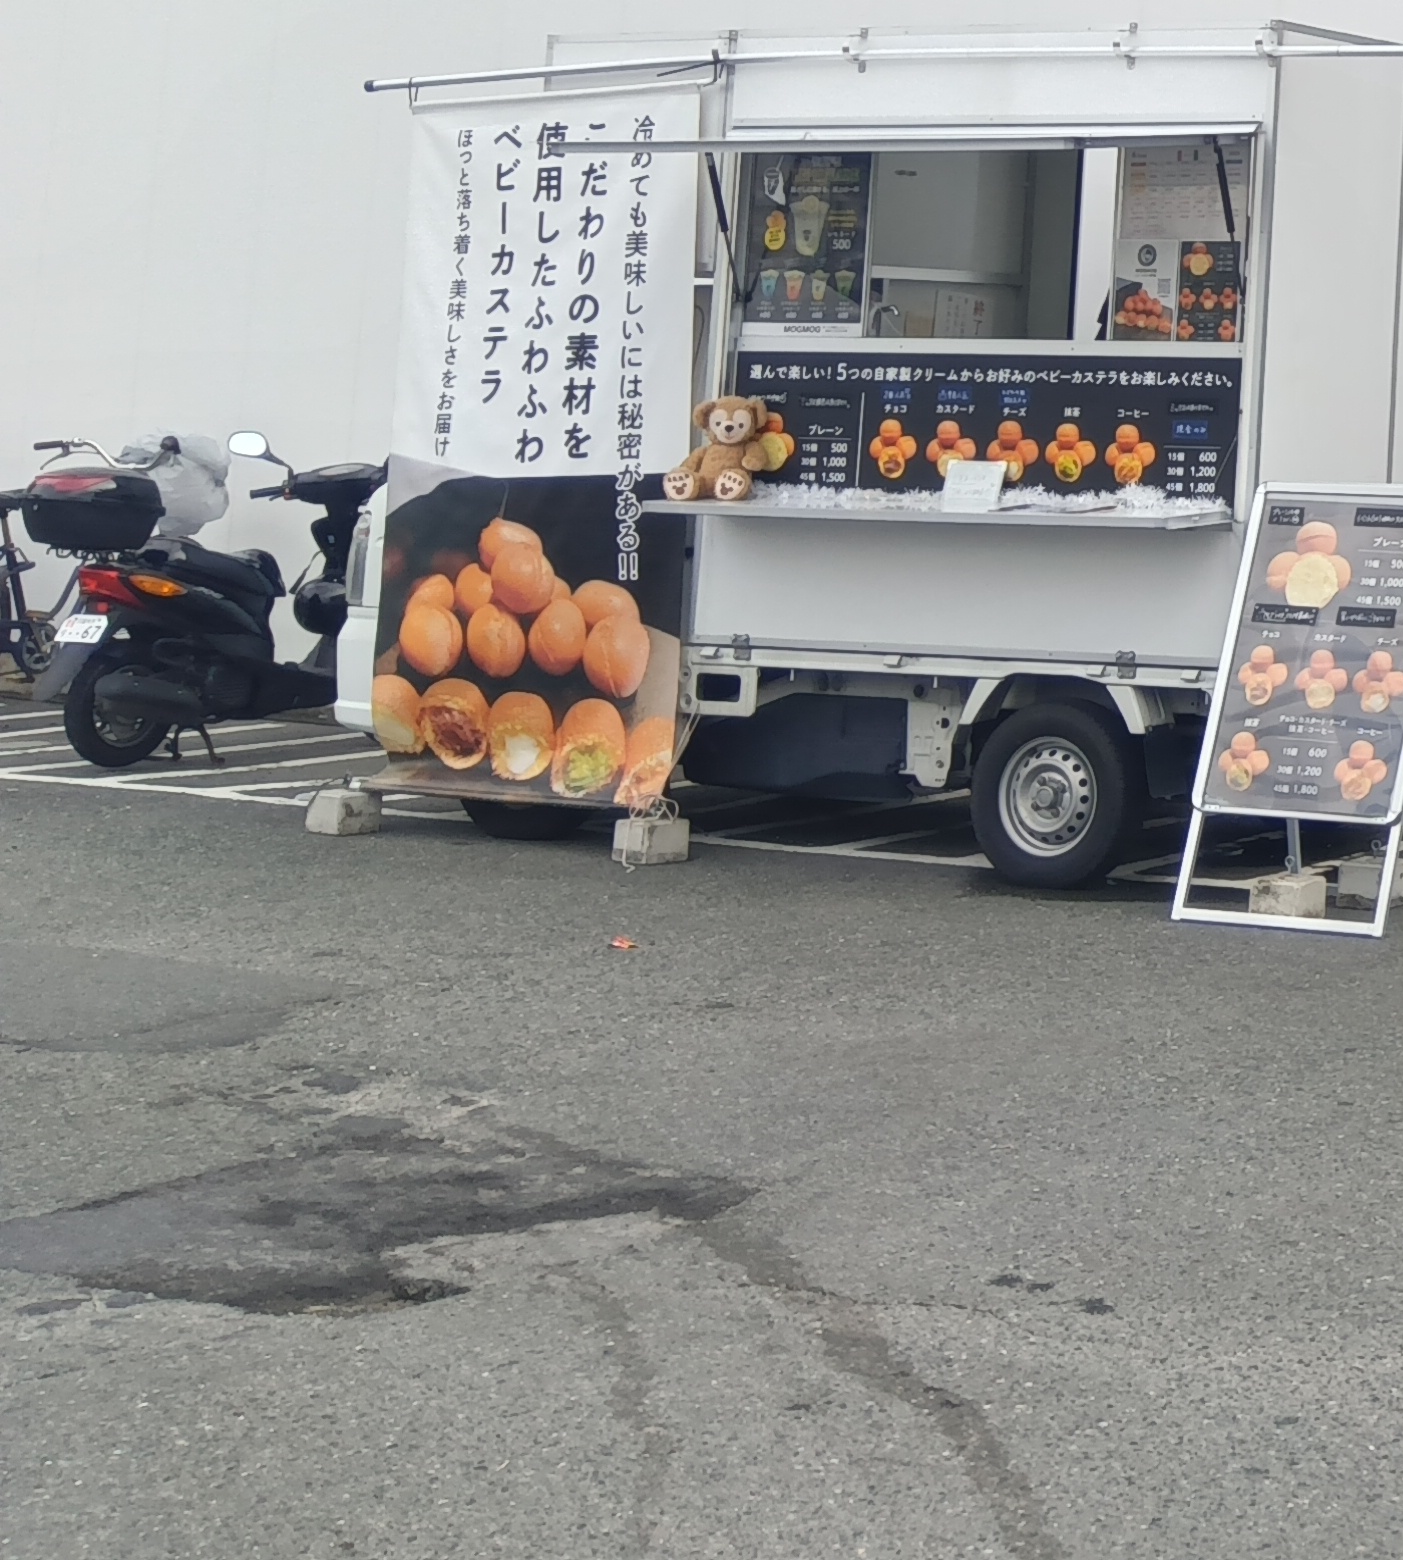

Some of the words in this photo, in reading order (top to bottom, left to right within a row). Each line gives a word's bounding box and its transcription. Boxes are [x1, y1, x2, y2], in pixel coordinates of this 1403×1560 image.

[832, 239, 851, 250] 500
[481, 123, 523, 405] ベビーカステラ
[434, 129, 474, 458] ほっと落ち着く美味しさをお届け
[516, 122, 568, 464] 使用したふわふわ
[883, 404, 908, 414] チョコ
[935, 404, 976, 415] カスタード
[1002, 406, 1027, 417] チーズ
[1116, 409, 1150, 418] コーヒー
[808, 424, 844, 436] プレーン
[830, 442, 848, 453] 500
[822, 456, 847, 468] 1,000
[1198, 451, 1218, 463] 600
[821, 471, 846, 483] 1,500
[1190, 465, 1217, 477] 1,200
[1189, 481, 1216, 493] 1,800
[1376, 594, 1402, 606] 1,500
[1261, 630, 1281, 639] チョコ
[1376, 637, 1399, 646] チーズ
[1356, 727, 1383, 736] コーヒー
[1308, 746, 1328, 758] 600
[1296, 765, 1322, 777] 1,200
[1293, 783, 1319, 796] 1,800
